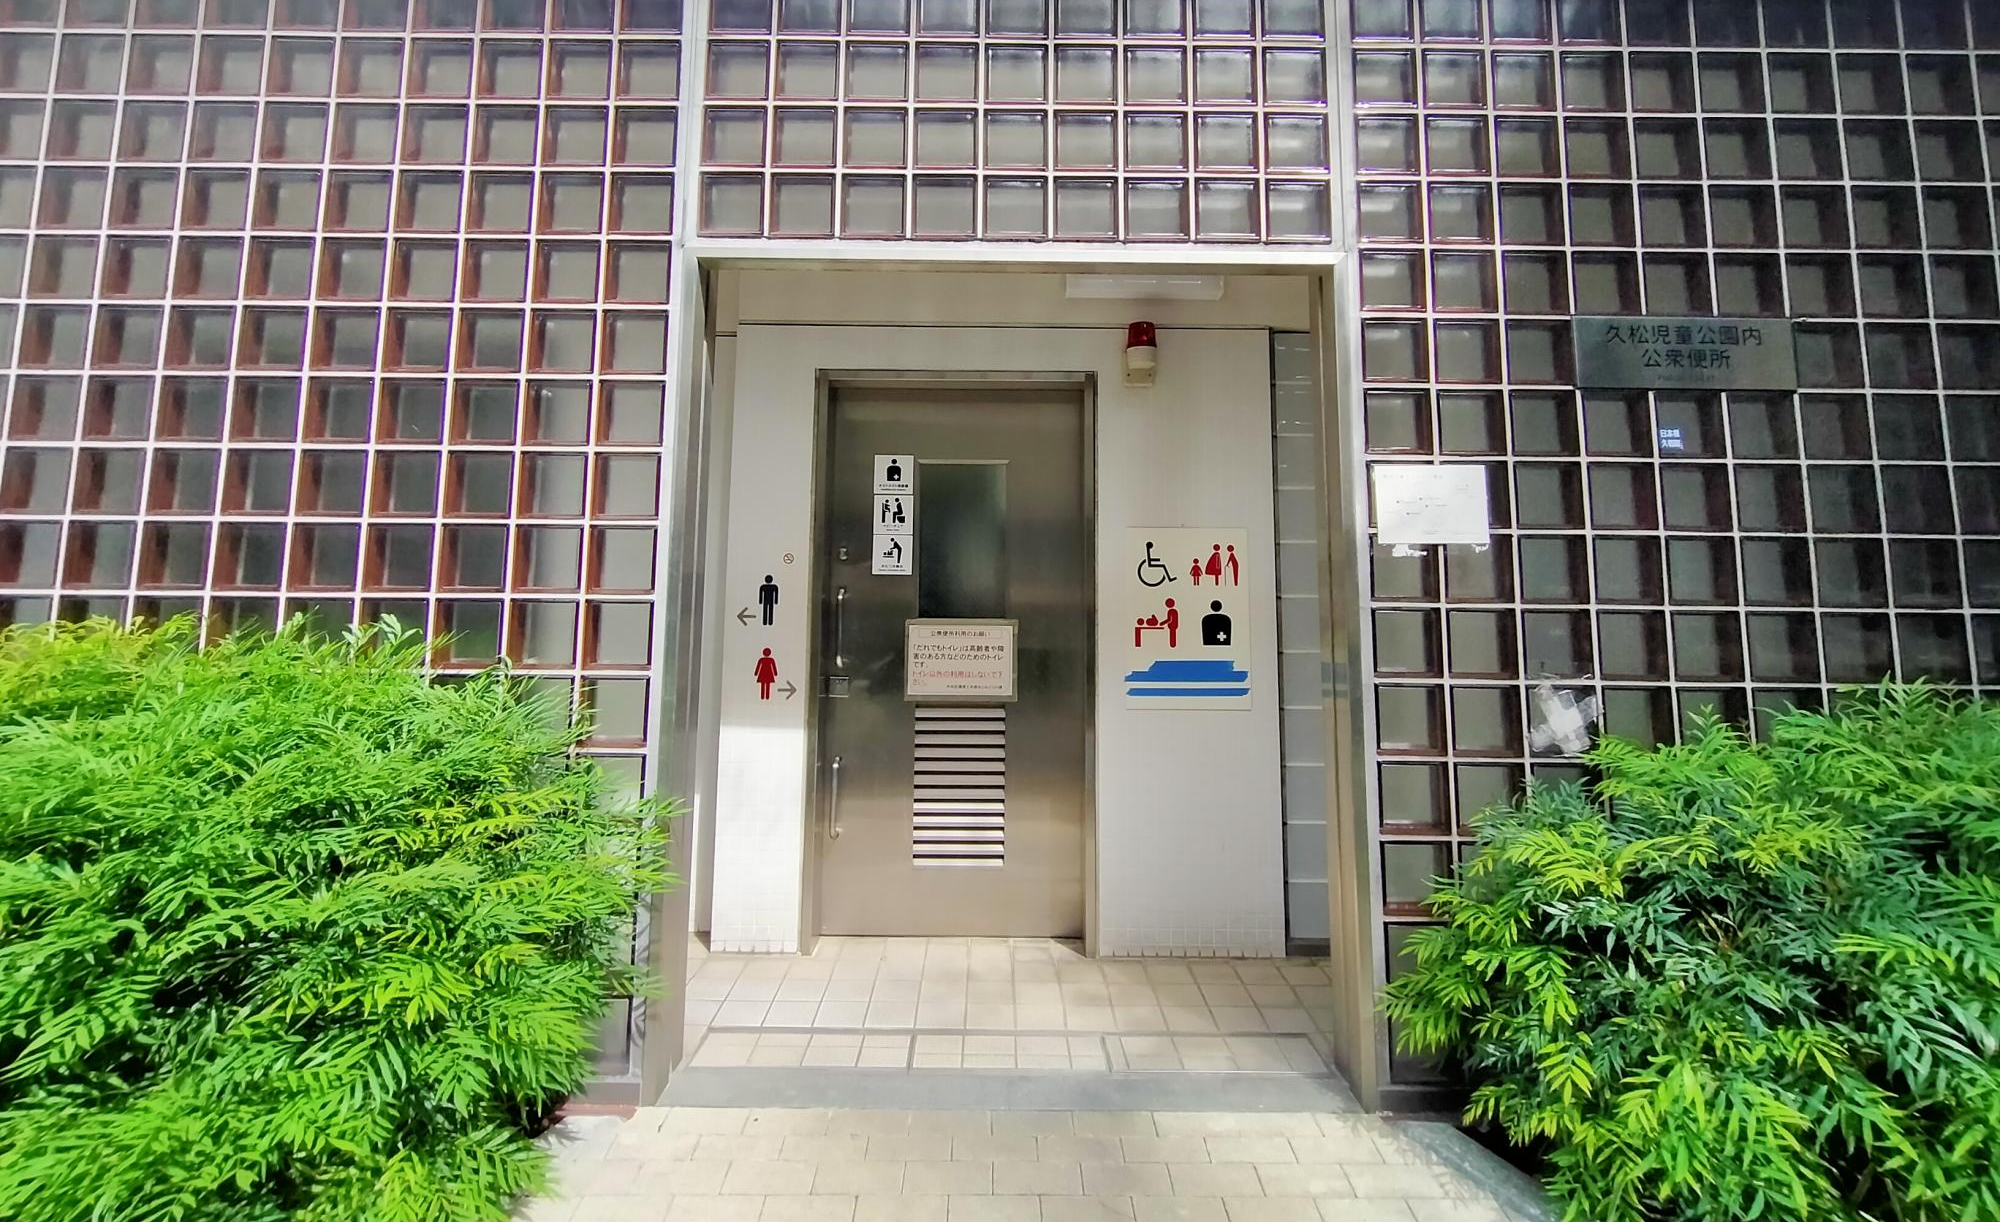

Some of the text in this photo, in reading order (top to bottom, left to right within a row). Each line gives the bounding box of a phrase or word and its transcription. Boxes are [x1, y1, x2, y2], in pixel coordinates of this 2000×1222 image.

[1605, 324, 1762, 346] 久松児童公園内
[1643, 348, 1731, 369] 公衆便所
